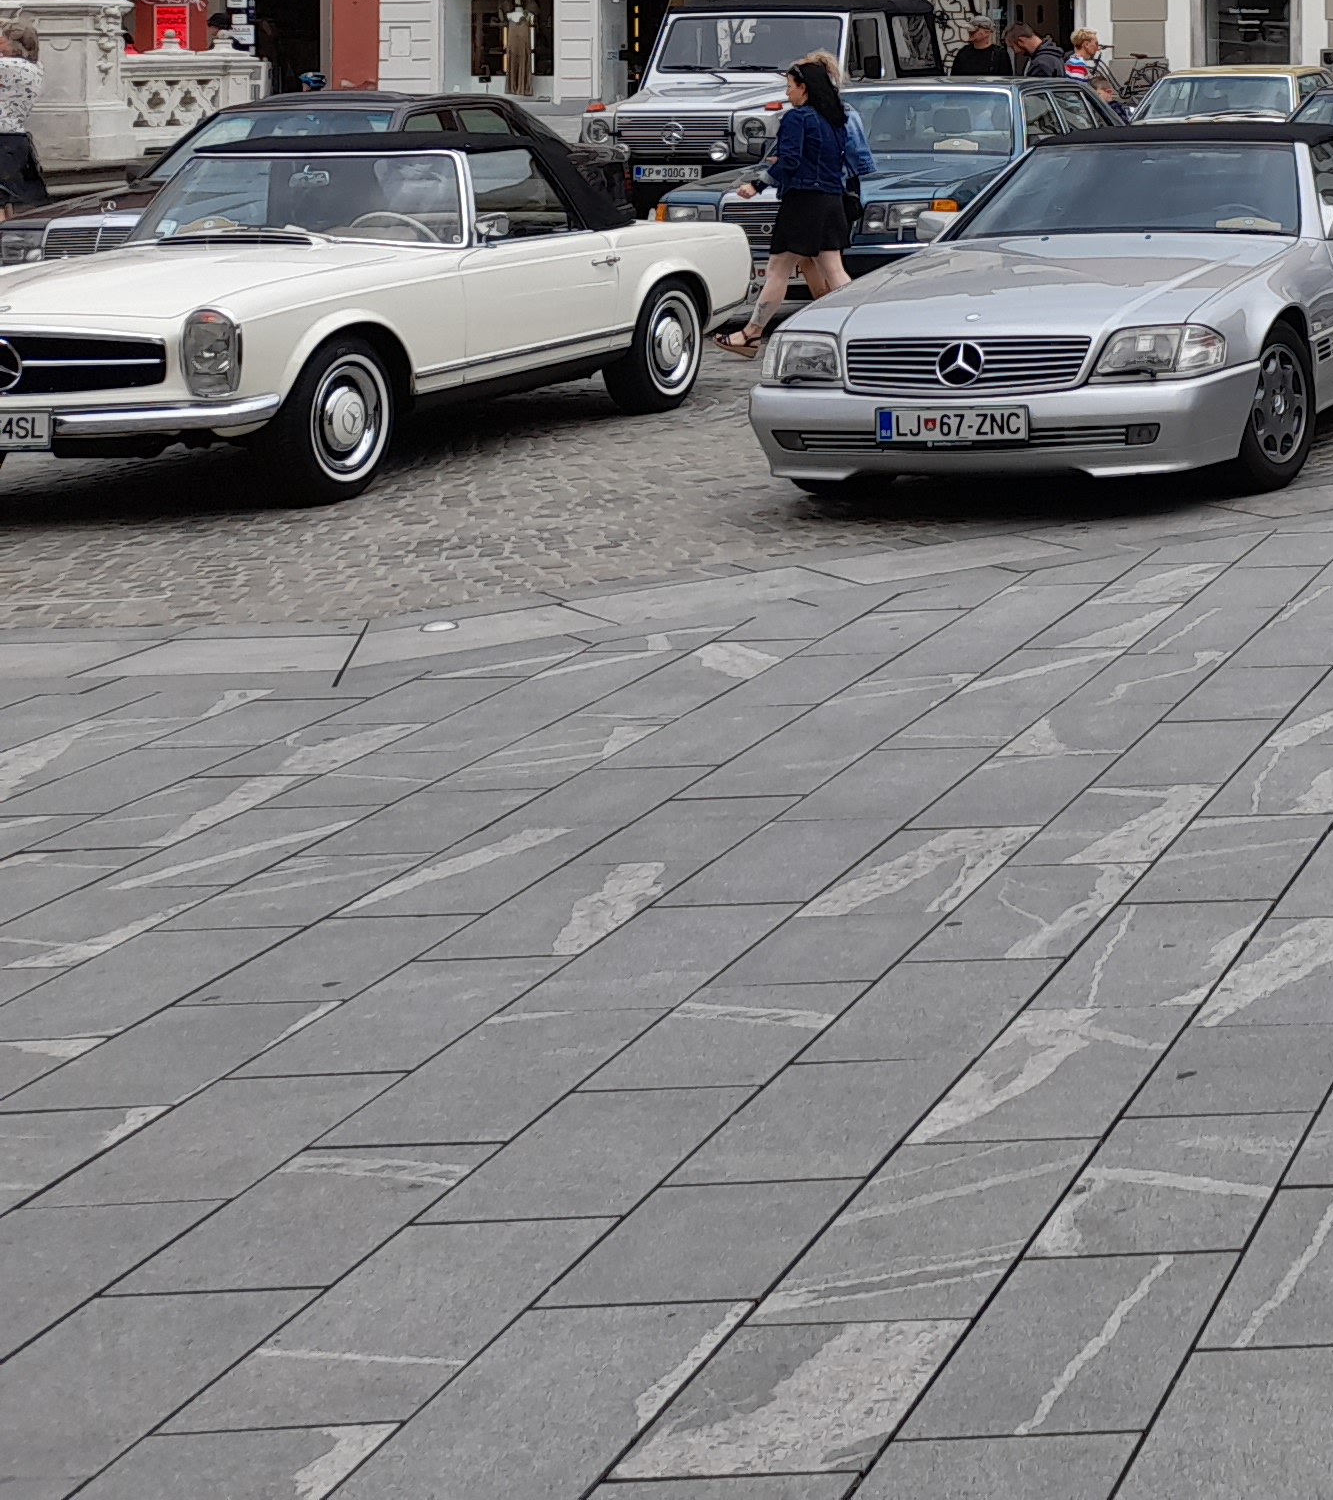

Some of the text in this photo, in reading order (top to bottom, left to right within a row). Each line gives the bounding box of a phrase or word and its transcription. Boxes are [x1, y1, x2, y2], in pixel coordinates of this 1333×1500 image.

[0, 416, 44, 440] 4SL
[896, 412, 1021, 437] LJ 67-ZNC
